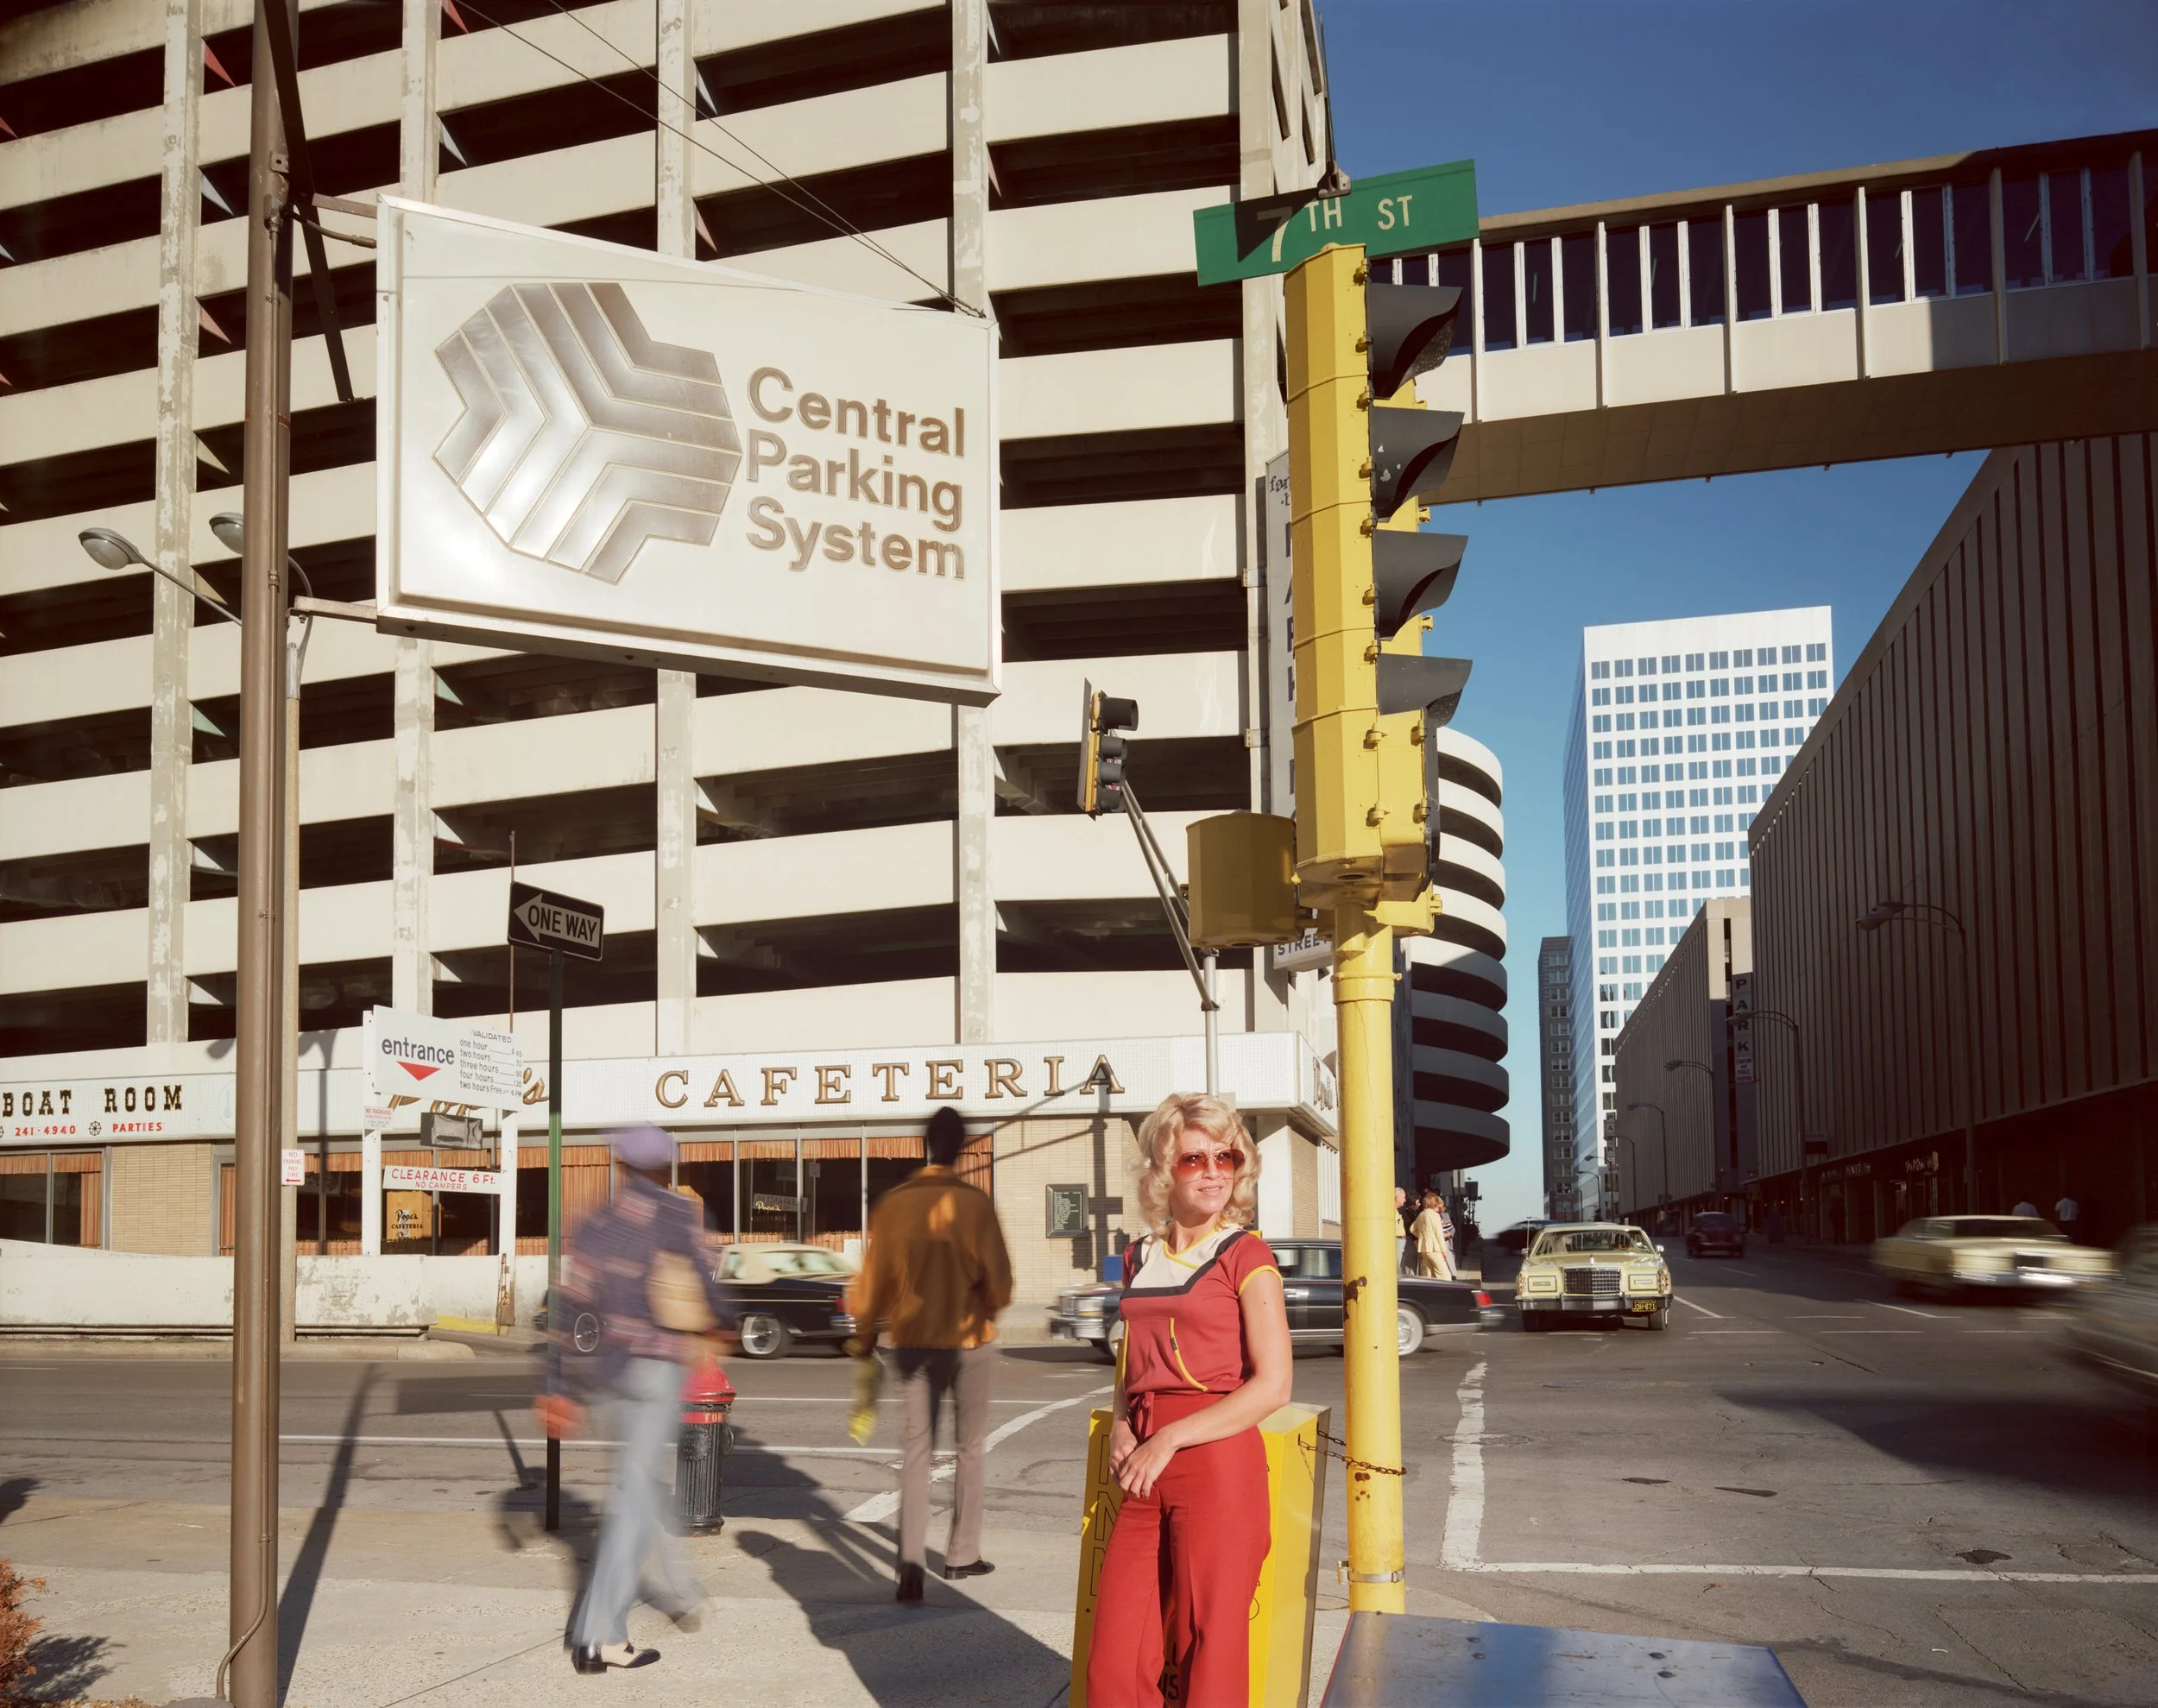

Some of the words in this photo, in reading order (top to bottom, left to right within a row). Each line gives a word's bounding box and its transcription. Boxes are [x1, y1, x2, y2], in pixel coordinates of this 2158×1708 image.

[1257, 195, 1342, 262] 7TH
[1378, 195, 1412, 230] ST
[748, 366, 965, 458] Central
[747, 428, 963, 533] Parking
[746, 495, 965, 580] System
[528, 904, 562, 934] ONE
[565, 914, 597, 942] WAY
[1278, 934, 1327, 956] STREE
[460, 1038, 471, 1047] one
[473, 1039, 488, 1051] hour
[472, 1030, 512, 1043] VALIDATED
[382, 1037, 455, 1065] entrance
[460, 1049, 472, 1058] two
[473, 1050, 491, 1062] hours
[460, 1059, 478, 1070] three
[479, 1062, 499, 1074] hours
[460, 1069, 474, 1080] four
[476, 1072, 495, 1084] hours
[654, 1054, 1126, 1109] CAFETERIA
[460, 1081, 471, 1090] two
[472, 1082, 490, 1093] hours
[3, 1089, 73, 1118] BOAT
[104, 1084, 182, 1113] ROOM
[112, 1122, 163, 1133] PARTIES
[391, 1169, 465, 1183] CLEARANCE
[472, 1174, 480, 1183] 6
[483, 1175, 496, 1185] Ft.
[428, 1182, 468, 1190] CAMPERS
[395, 1209, 419, 1222] Pope's
